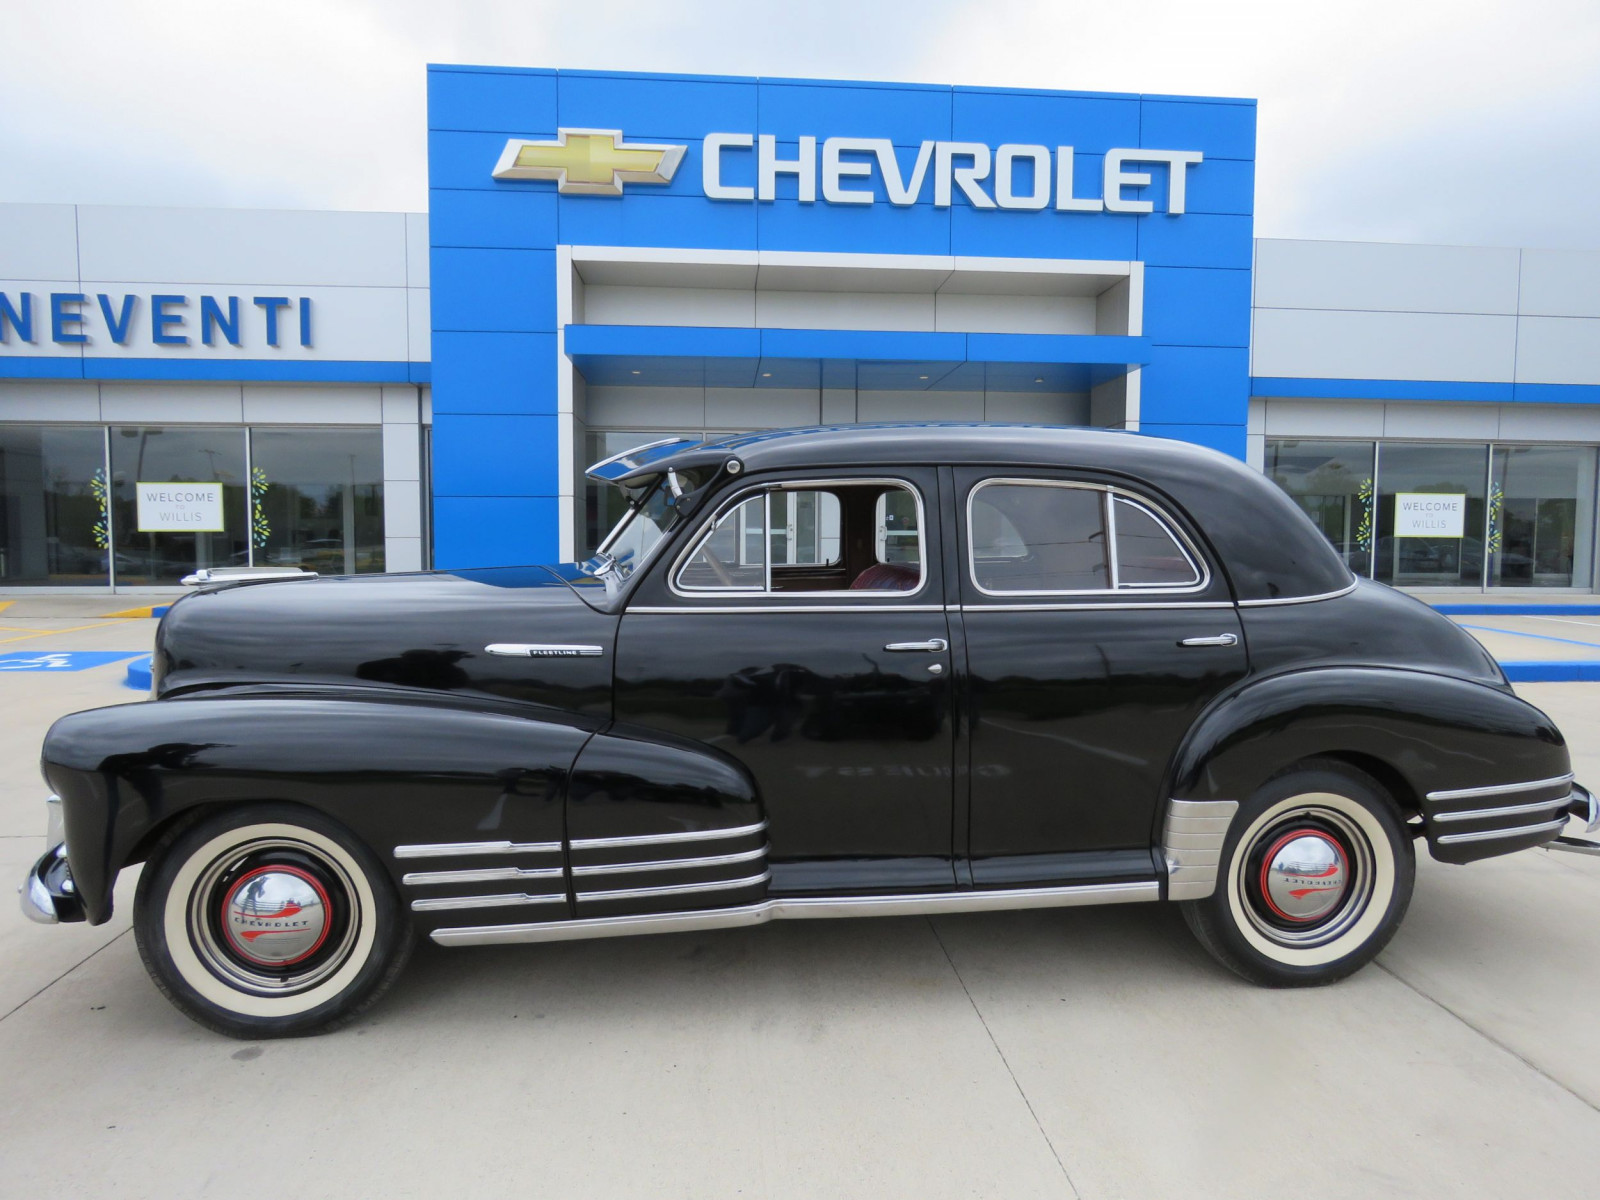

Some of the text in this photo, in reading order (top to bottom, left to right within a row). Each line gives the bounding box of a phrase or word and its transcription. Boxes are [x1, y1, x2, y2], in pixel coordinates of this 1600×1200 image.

[702, 132, 1203, 215] CHEVROLET
[0, 291, 313, 347] NEVENTI
[146, 492, 214, 502] WELCOME
[1402, 502, 1458, 511] WELCOME
[159, 511, 202, 522] WILLIS
[1411, 519, 1447, 529] WILLIS
[234, 917, 308, 928] CHEVROLET
